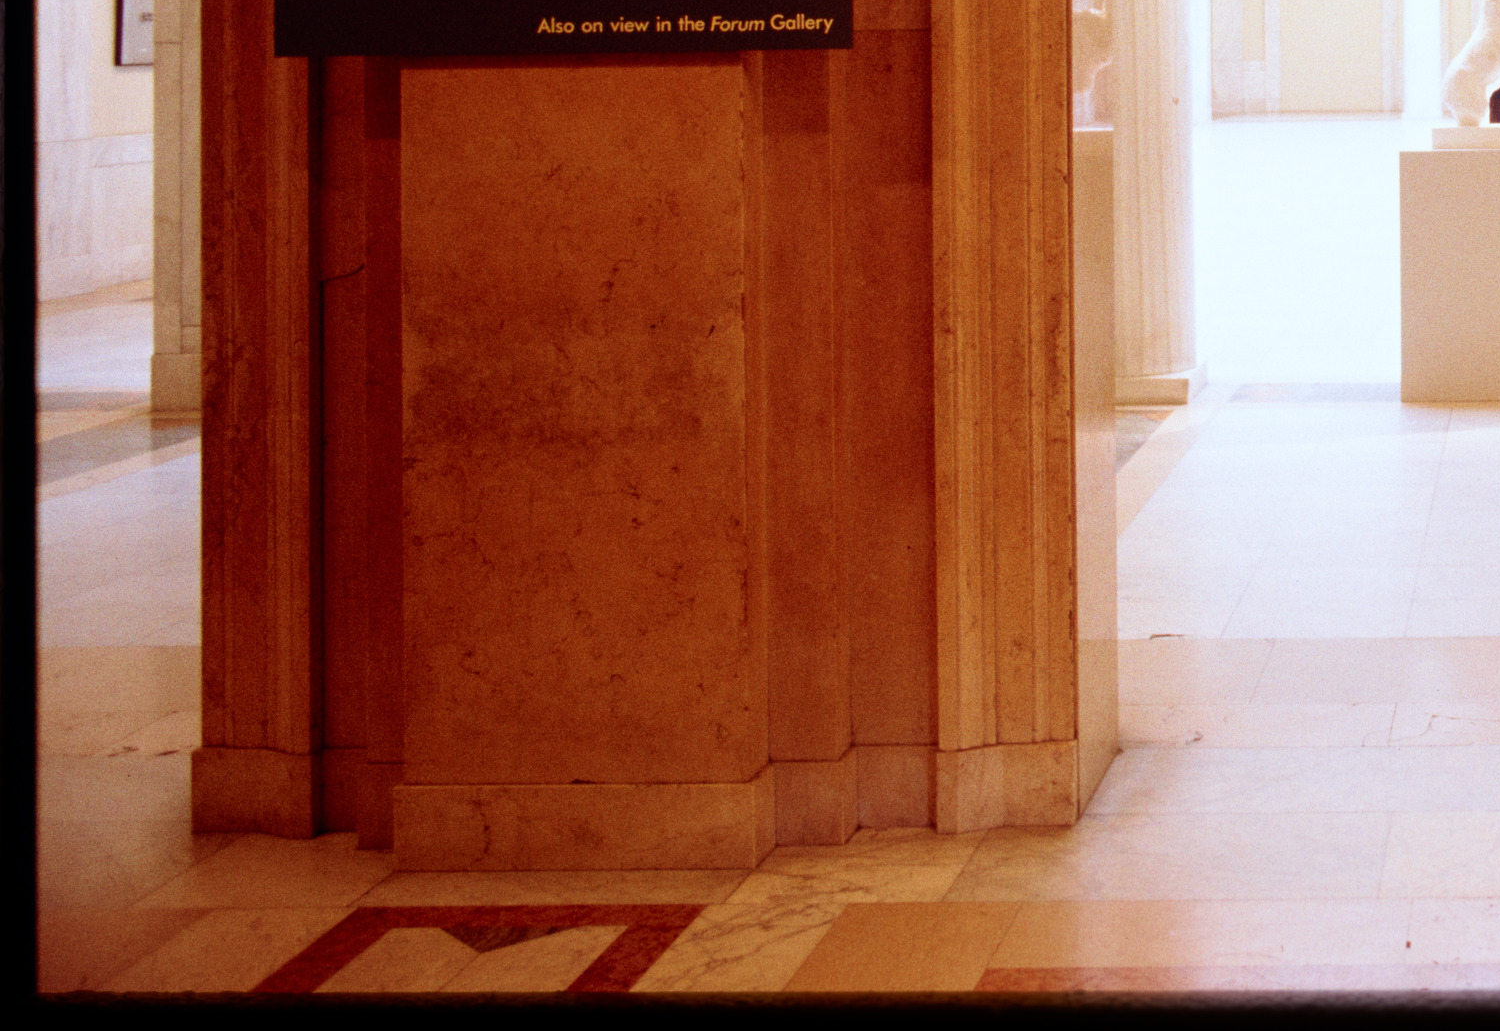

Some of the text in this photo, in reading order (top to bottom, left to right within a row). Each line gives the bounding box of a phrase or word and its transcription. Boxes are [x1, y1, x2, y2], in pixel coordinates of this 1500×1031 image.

[536, 12, 835, 35] Also on view in the Forum Gallery
